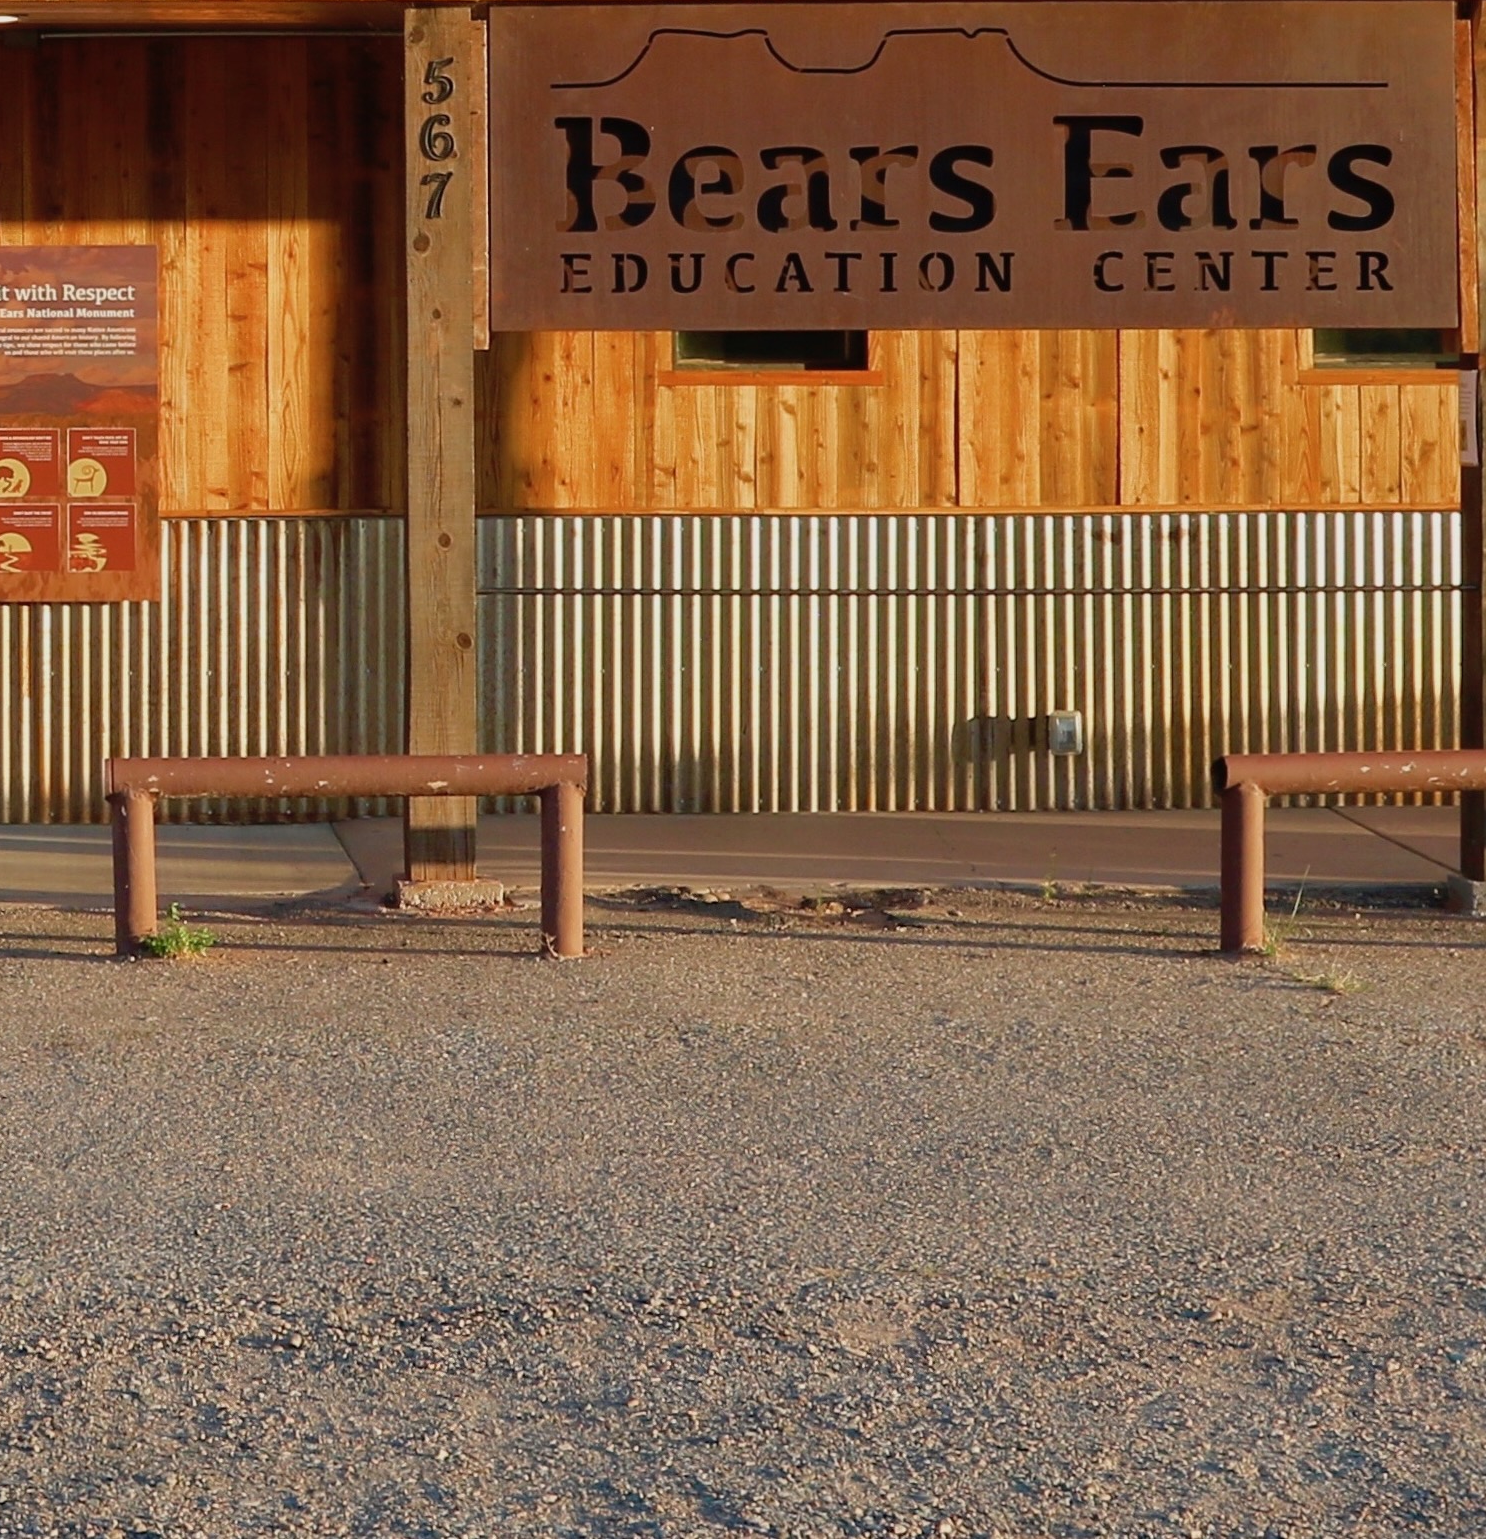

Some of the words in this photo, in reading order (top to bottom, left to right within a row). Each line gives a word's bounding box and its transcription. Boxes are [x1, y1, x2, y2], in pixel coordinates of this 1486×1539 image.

[419, 56, 455, 219] 567
[554, 116, 996, 233] Bears
[1052, 115, 1395, 232] Ears
[559, 251, 1015, 293] EDUCATION
[1092, 250, 1394, 292] CENTER
[0, 308, 24, 318] Ears
[26, 308, 74, 318] National
[76, 308, 135, 318] Monument
[14, 284, 57, 301] with
[63, 284, 136, 305] Respect
